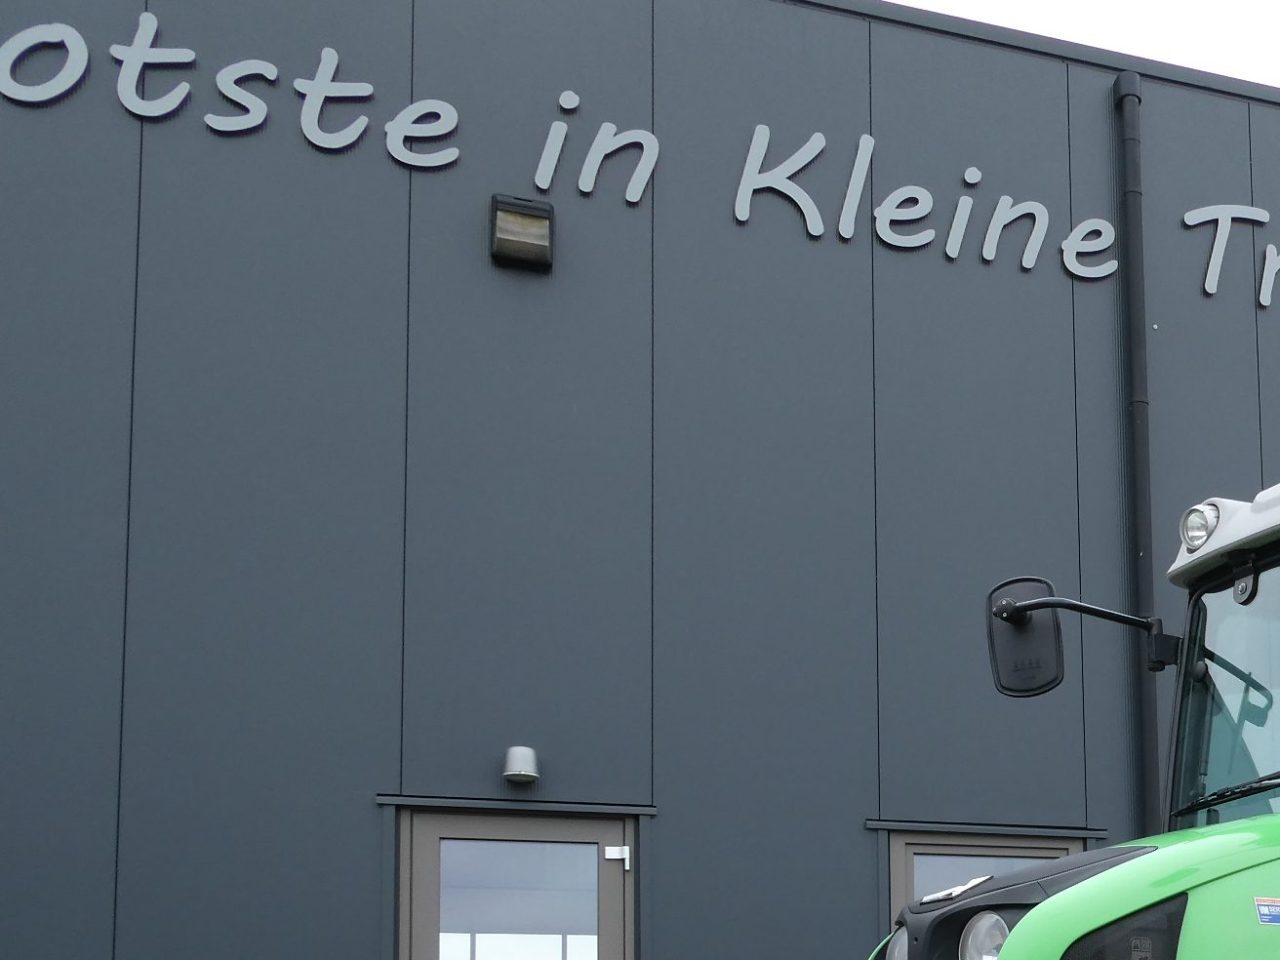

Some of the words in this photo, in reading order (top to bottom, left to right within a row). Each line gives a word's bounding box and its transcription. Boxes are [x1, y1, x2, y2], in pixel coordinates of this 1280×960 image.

[0, 12, 460, 166] otste
[534, 90, 660, 203] in
[734, 124, 1119, 278] Kleine
